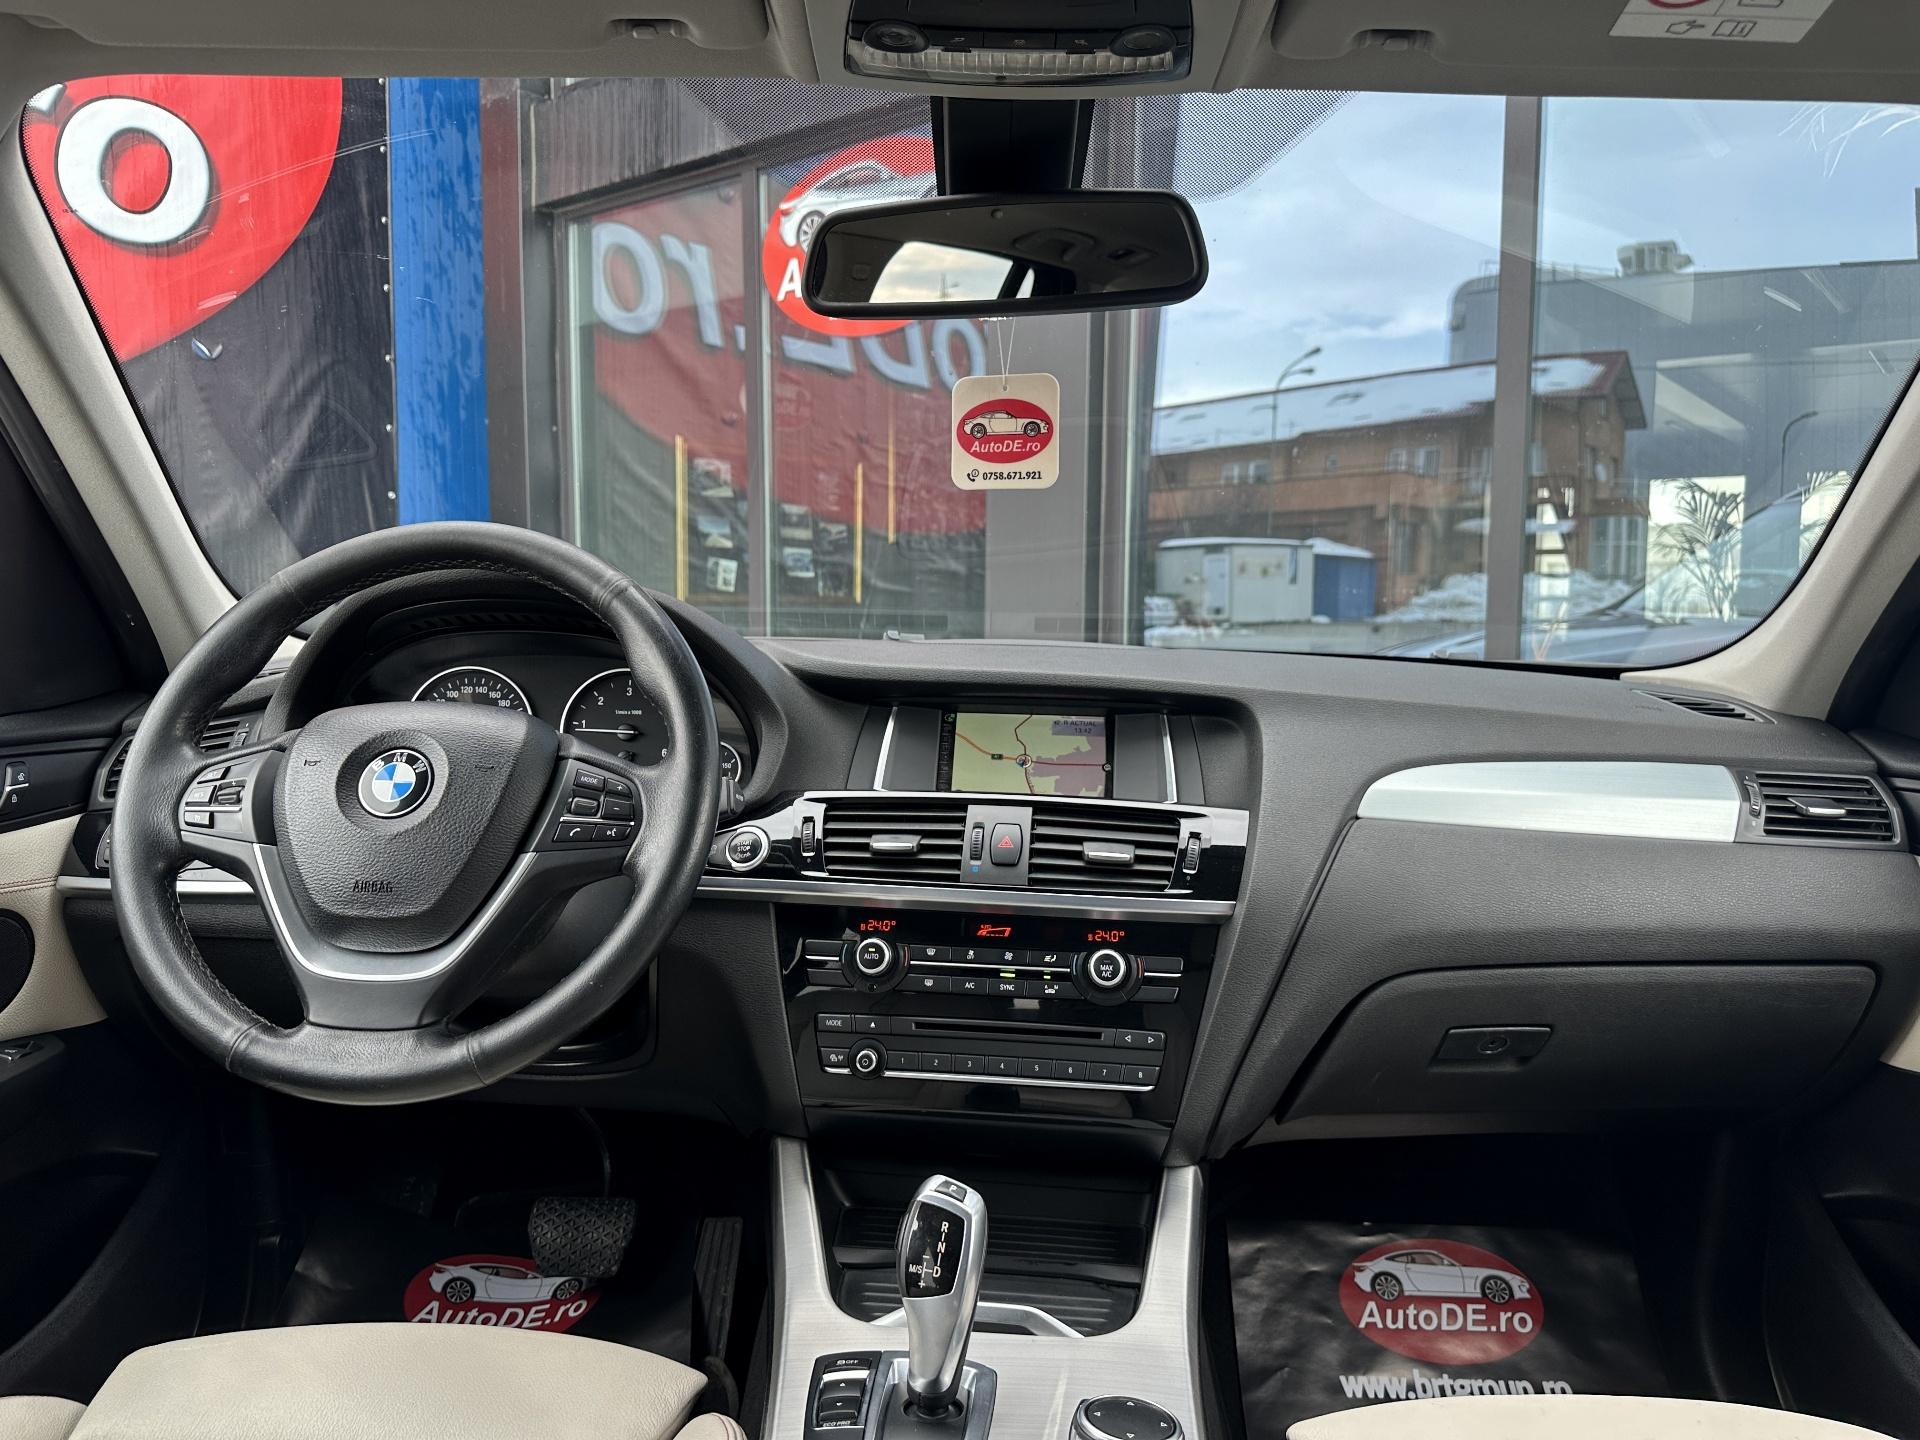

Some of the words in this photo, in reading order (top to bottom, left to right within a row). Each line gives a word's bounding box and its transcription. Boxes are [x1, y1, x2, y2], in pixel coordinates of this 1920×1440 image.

[970, 439, 1041, 453] AutoDE.ro
[982, 470, 1043, 481] 0758.671.921
[446, 690, 459, 699] 100
[488, 691, 501, 699] 160
[460, 685, 474, 694] 120
[475, 685, 488, 694] 140
[626, 687, 633, 697] 3
[497, 699, 511, 708] 180
[597, 696, 605, 706] 2
[581, 719, 586, 729] 1
[371, 752, 427, 774] BMW
[721, 762, 732, 770] 150
[580, 775, 599, 785] MODE
[352, 879, 393, 894] AIRBAG
[1000, 983, 1015, 991] SYNC
[826, 1019, 843, 1027] MODE
[941, 1221, 949, 1233] R
[937, 1241, 946, 1254] N
[908, 1263, 923, 1274] M/S
[932, 1266, 941, 1278] D
[411, 1299, 588, 1328] AutoDE.ro
[1358, 1301, 1534, 1334] AutoDE.ro
[1339, 1368, 1573, 1400] www.brtgroupro
